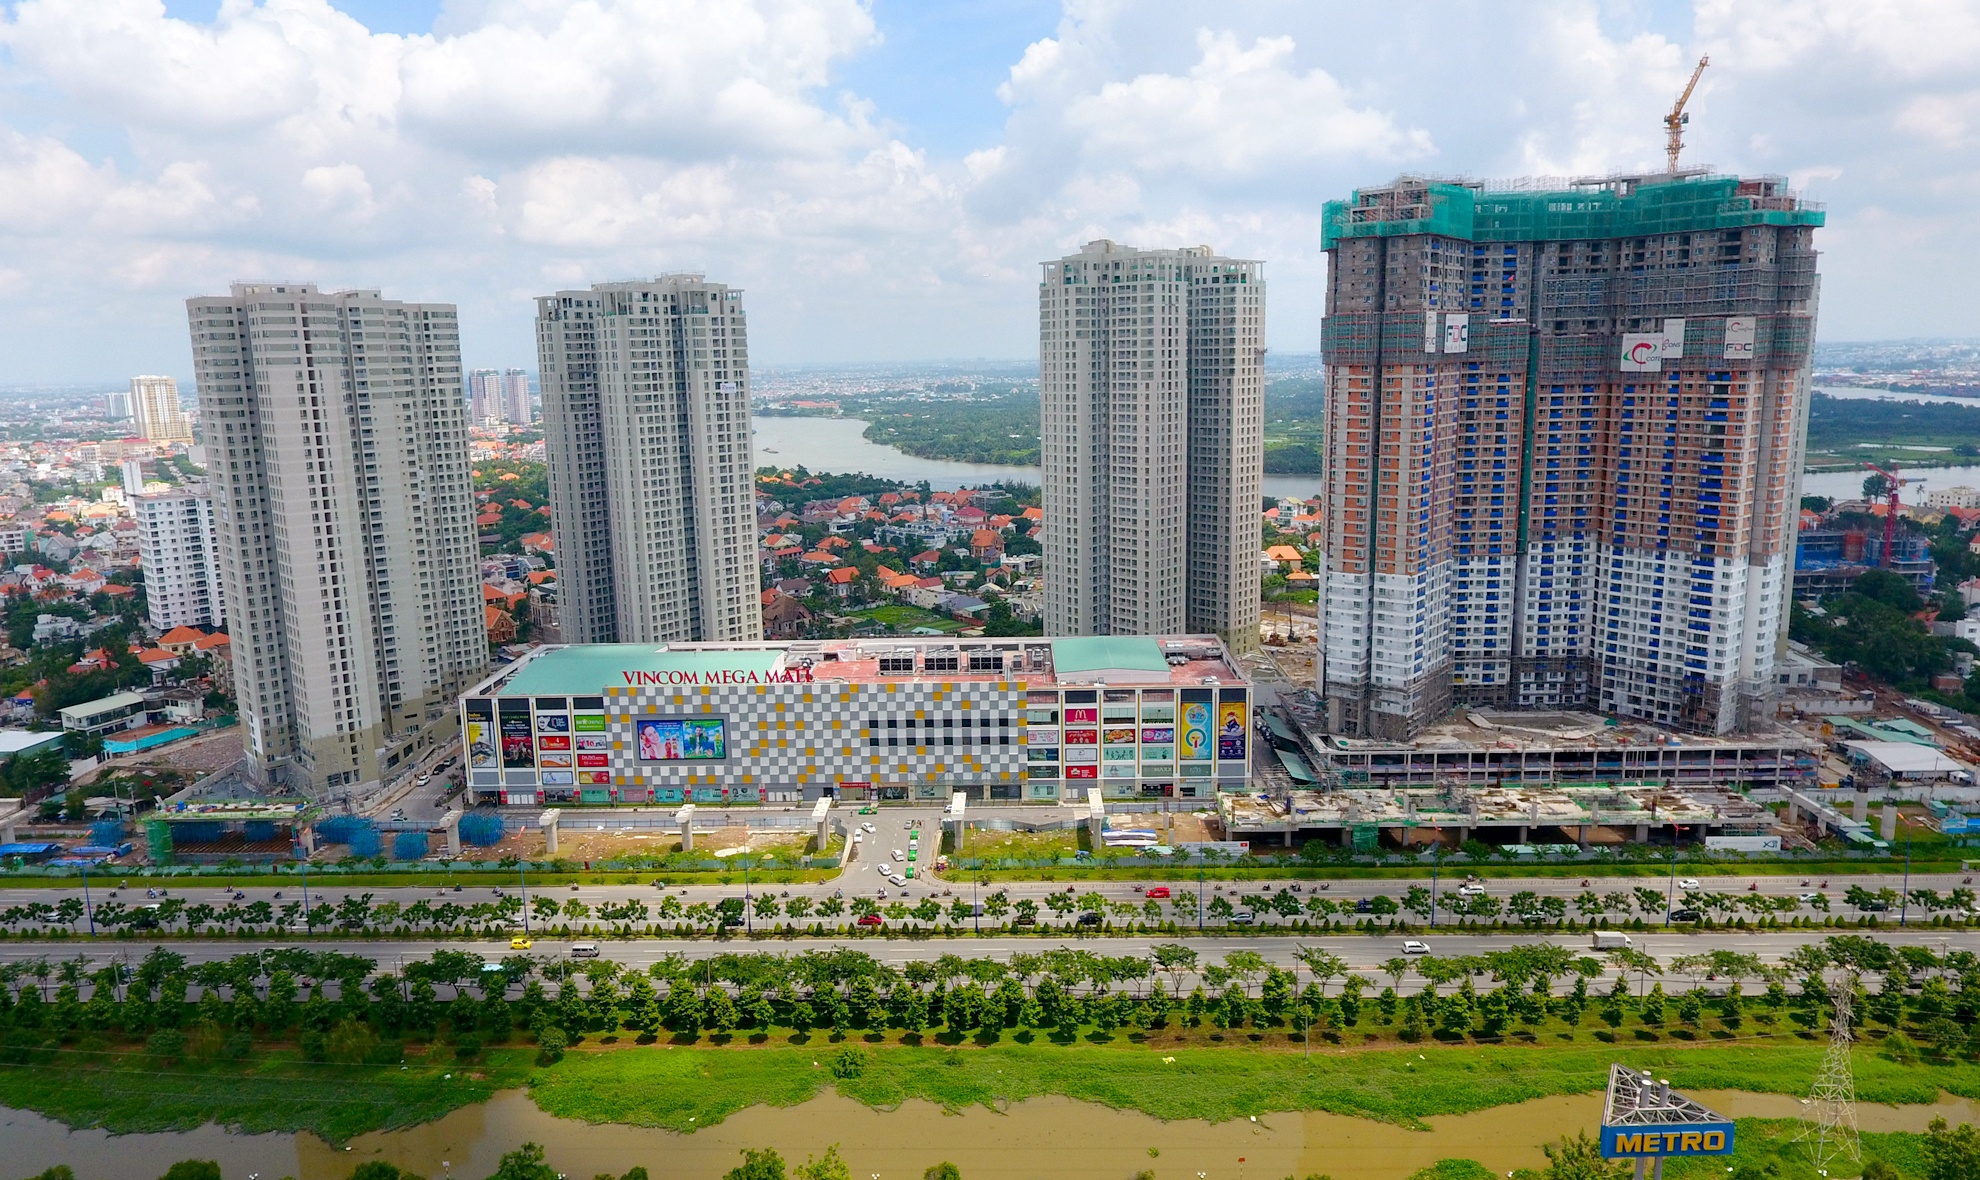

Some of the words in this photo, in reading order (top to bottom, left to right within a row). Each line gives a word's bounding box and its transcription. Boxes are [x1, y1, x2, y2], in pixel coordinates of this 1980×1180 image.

[1446, 325, 1467, 342] FDC
[1726, 343, 1752, 351] FDC
[622, 670, 700, 685] VINCOM
[704, 669, 759, 684] MEGA
[763, 668, 816, 684] MALL
[1616, 1130, 1726, 1153] METRO
